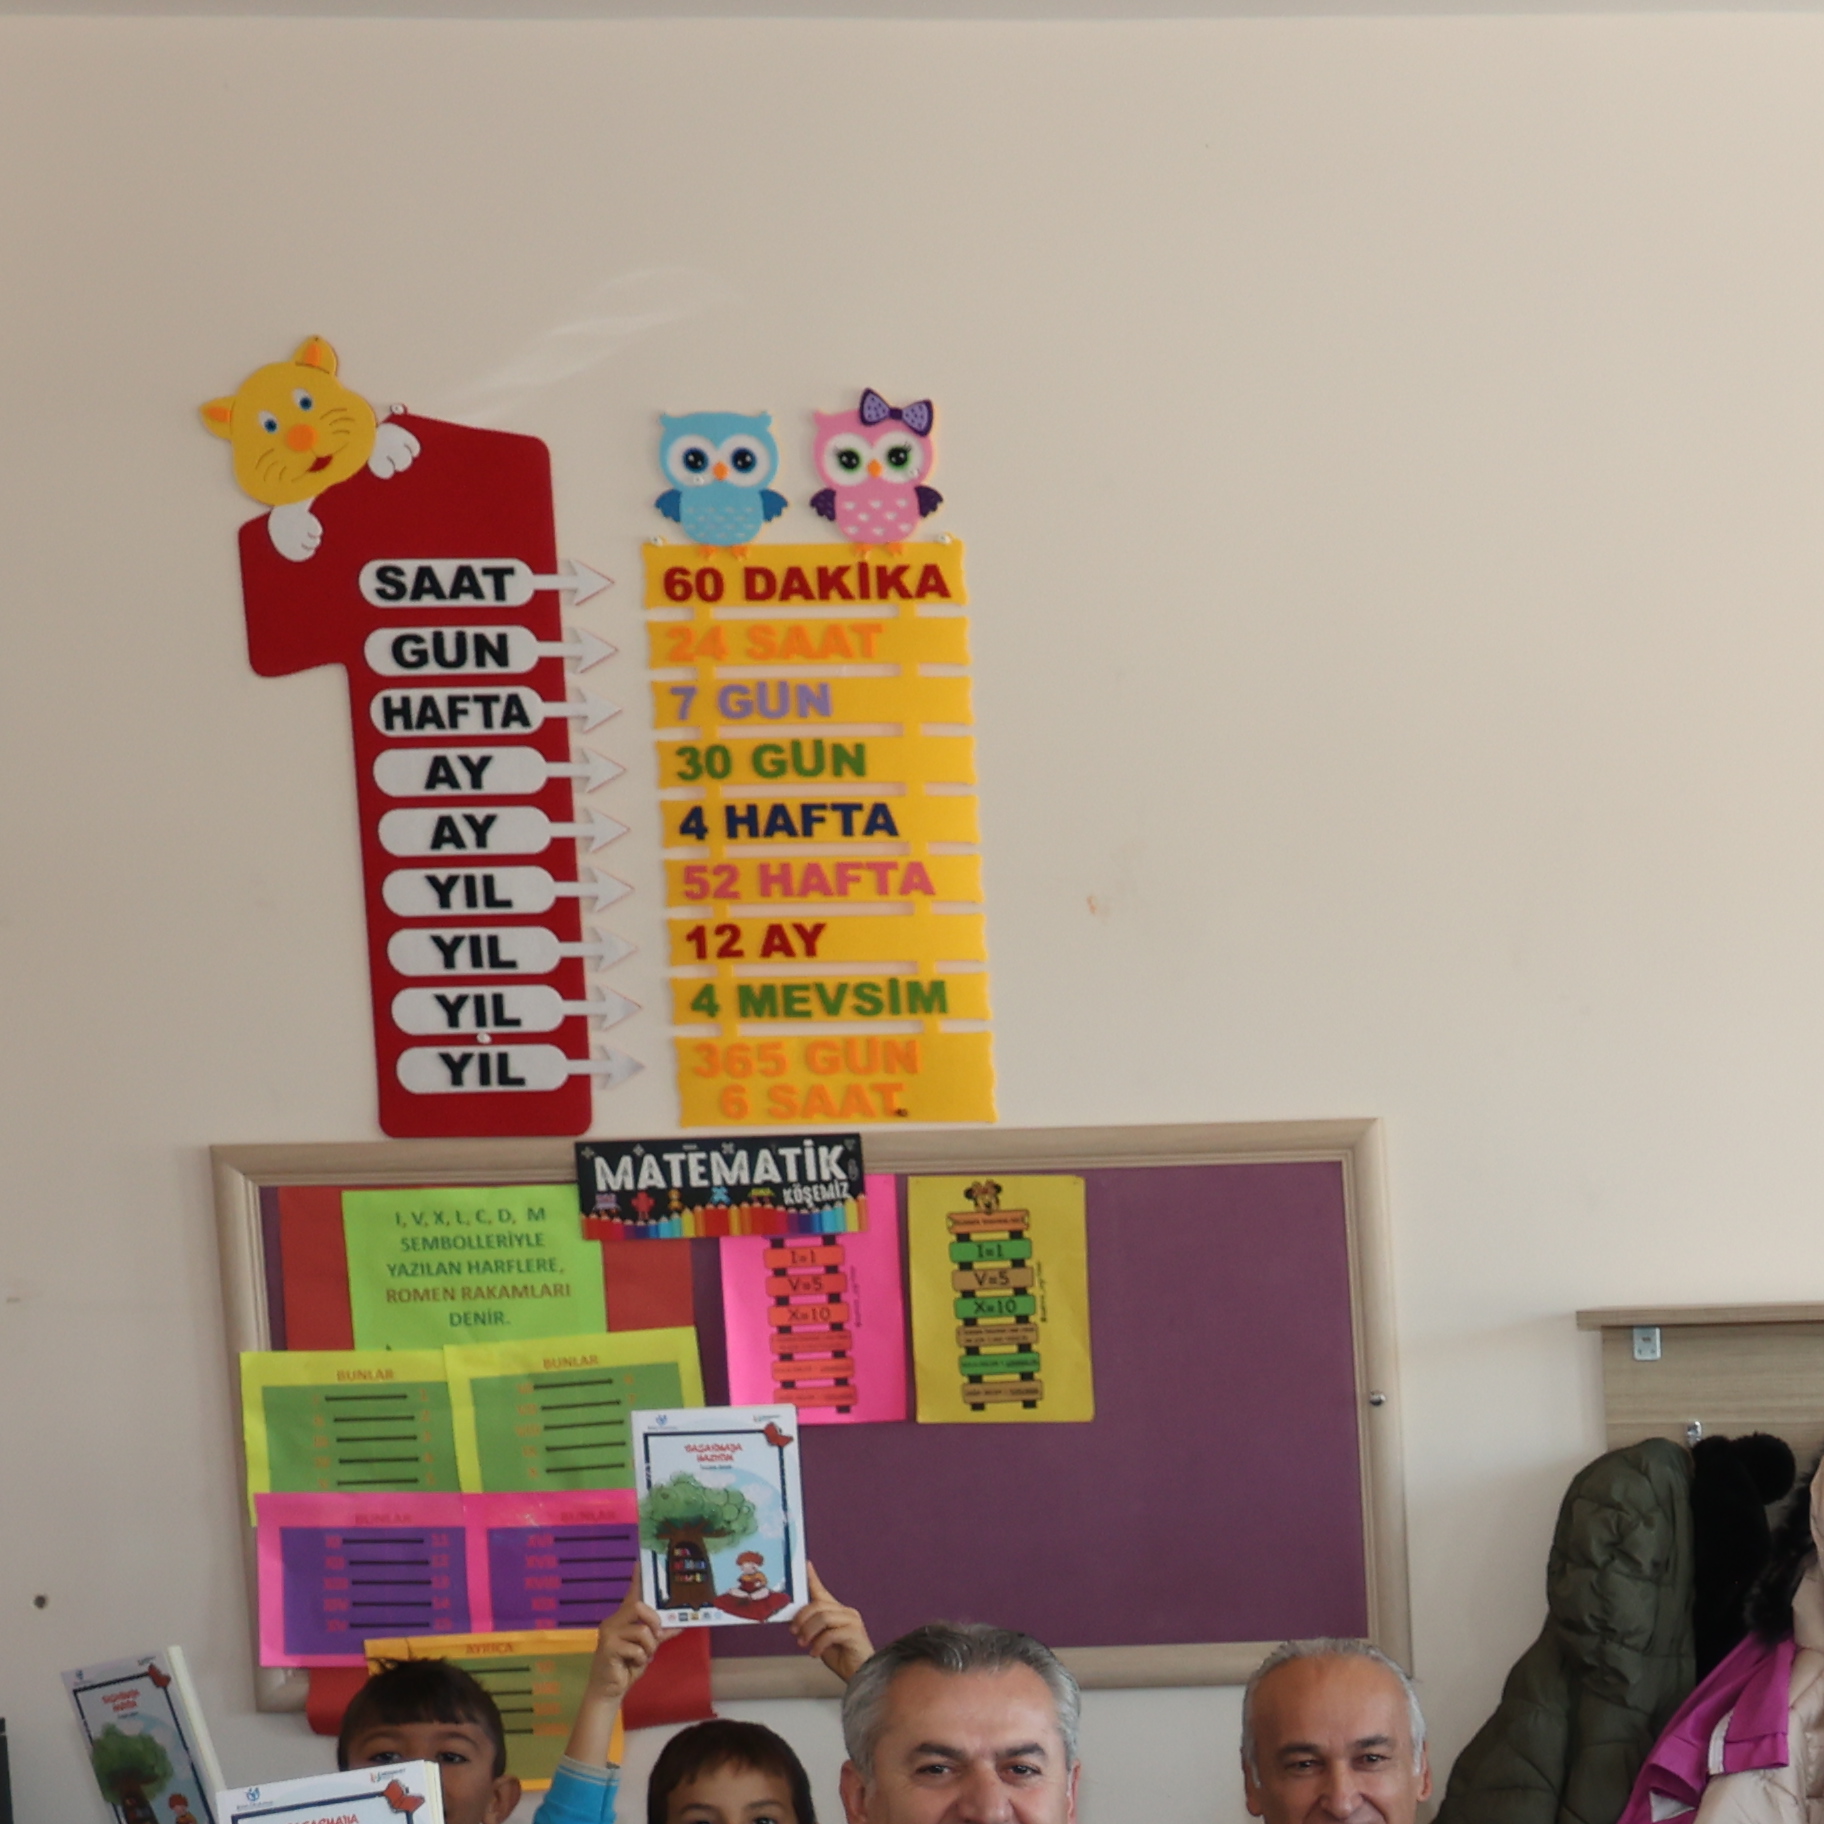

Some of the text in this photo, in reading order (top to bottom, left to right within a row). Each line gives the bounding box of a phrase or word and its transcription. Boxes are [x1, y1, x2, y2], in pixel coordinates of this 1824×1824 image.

[375, 566, 515, 602] SAAT
[663, 561, 950, 603] 60 DAKİKA
[391, 629, 509, 669] GÜN
[667, 623, 883, 661] 24 SAAT
[383, 694, 531, 730] HAFTA
[670, 682, 831, 719] 7 GÜN
[424, 755, 492, 790] AY
[676, 740, 866, 780] 30 GÜN
[430, 815, 497, 849] AY
[679, 803, 899, 839] 4 HAFTA
[427, 875, 512, 909] YIL
[683, 861, 935, 899] 52 HAFTA
[432, 935, 517, 969] YIL
[687, 923, 826, 959] 12 AY
[435, 993, 522, 1028] YIL
[690, 977, 948, 1017] 4 MEVSİM
[440, 1052, 525, 1087] YIL
[692, 1036, 919, 1077] 365 GÜN
[720, 1084, 905, 1119] 6 SAAT
[593, 1139, 848, 1192] MATEMATİK
[782, 1180, 850, 1209] KÖŞEMİZ
[433, 1211, 450, 1226] X,
[475, 1209, 491, 1225] C,
[498, 1208, 516, 1225] D,
[528, 1207, 545, 1221] M
[401, 1231, 545, 1252] SEMBOLLERİYLE
[387, 1261, 461, 1277] YAZILAN
[788, 1276, 822, 1291] V=5
[974, 1271, 1009, 1286] V=5
[387, 1284, 571, 1303] ROMEN RAKAMLARI
[973, 1300, 1017, 1314] X=10
[449, 1310, 510, 1327] DENİR.
[788, 1307, 831, 1322] X=10
[337, 1369, 394, 1382] BUNLAR
[543, 1355, 599, 1370] BUNLAR
